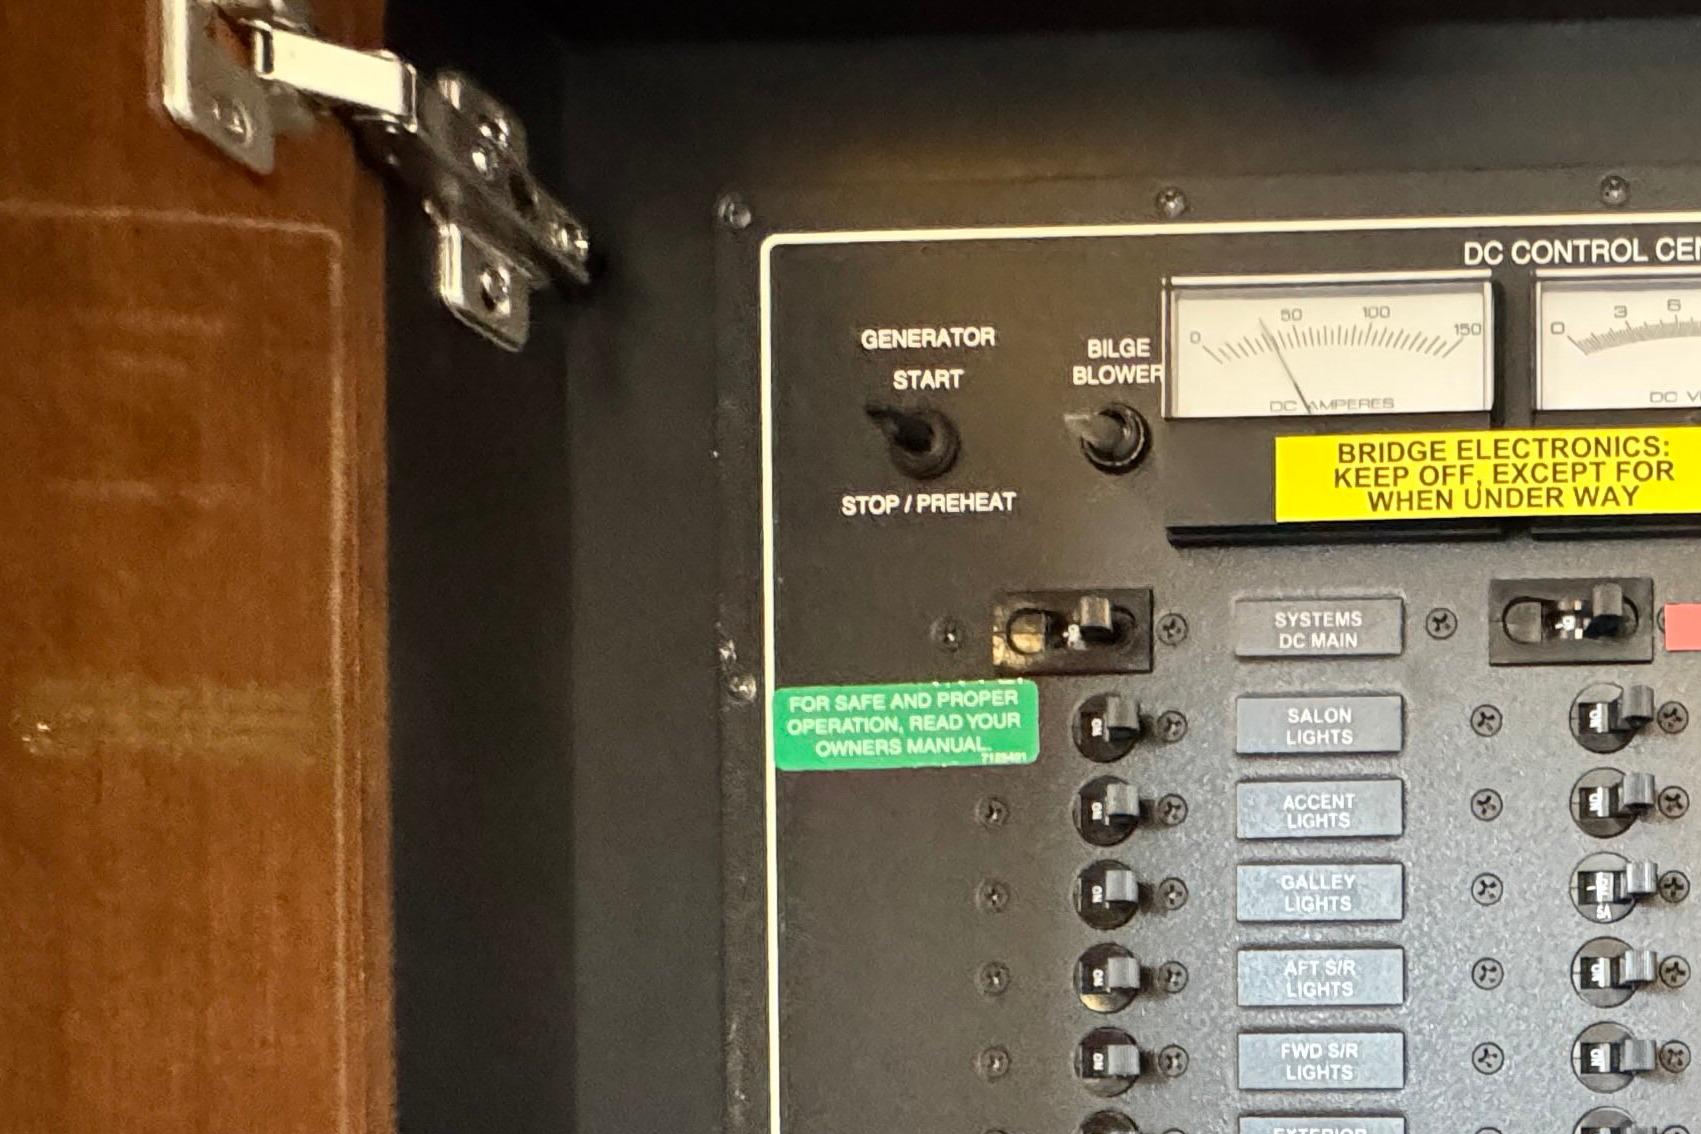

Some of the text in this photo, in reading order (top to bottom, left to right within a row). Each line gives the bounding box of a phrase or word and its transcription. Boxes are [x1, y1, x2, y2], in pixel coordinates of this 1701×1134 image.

[1464, 241, 1504, 265] DC
[1511, 238, 1649, 265] CONTROL
[1362, 306, 1391, 319] 100
[1613, 304, 1628, 318] 3
[1666, 298, 1682, 312] 6
[1280, 308, 1303, 322] 50
[1454, 322, 1482, 336] 150
[1550, 321, 1565, 335] 0
[861, 326, 995, 351] GENERATOR
[1189, 331, 1201, 345] 0
[1087, 338, 1151, 358] BILGE
[893, 368, 964, 391] START
[1072, 363, 1163, 386] BLOWER
[1269, 398, 1395, 412] DC AMPERES
[1649, 391, 1678, 403] DC
[1338, 436, 1671, 464] BRIDGE ELECTRONICS:
[1334, 460, 1675, 489] KEEP OFF, EXCEPT FOR
[841, 492, 1017, 515] STOP / PREHEAT
[1368, 486, 1640, 512] WHEN UNDER WAY
[1275, 611, 1362, 628] SYSTEMS
[1279, 632, 1358, 649] DC MAIN
[789, 690, 1019, 712] FOR SAFE AND PROPER
[786, 711, 1021, 735] OPERATION, READ YOUR
[1288, 708, 1352, 724] SALON
[1286, 728, 1353, 745] LIGHTS
[815, 738, 902, 757] OWNERS
